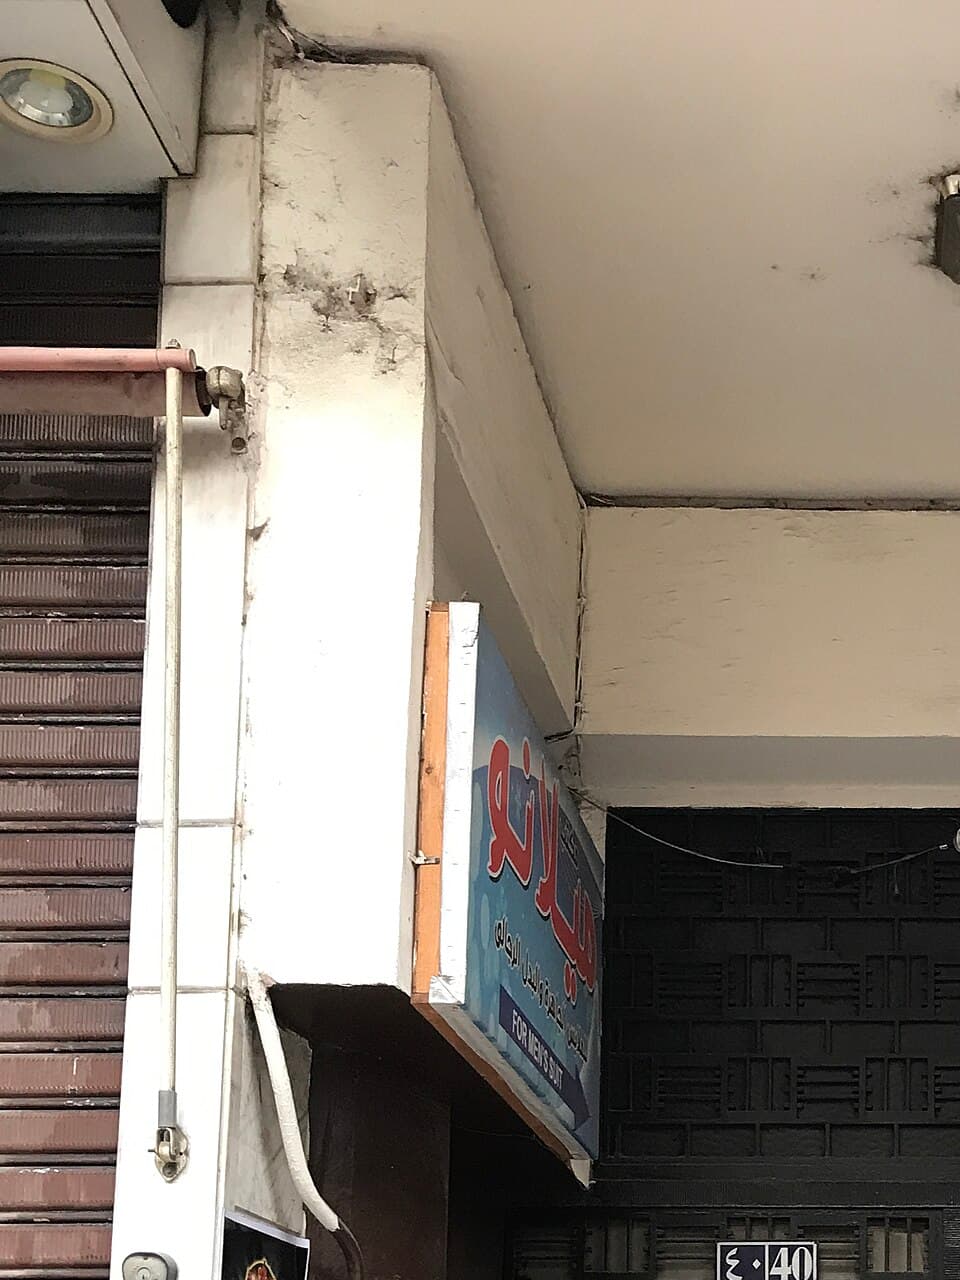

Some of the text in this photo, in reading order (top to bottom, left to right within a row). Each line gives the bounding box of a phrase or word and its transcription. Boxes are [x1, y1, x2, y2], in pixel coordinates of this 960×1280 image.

[487, 735, 597, 1006] ميلانو
[512, 1009, 563, 1089] FOR MEN'S SUIT
